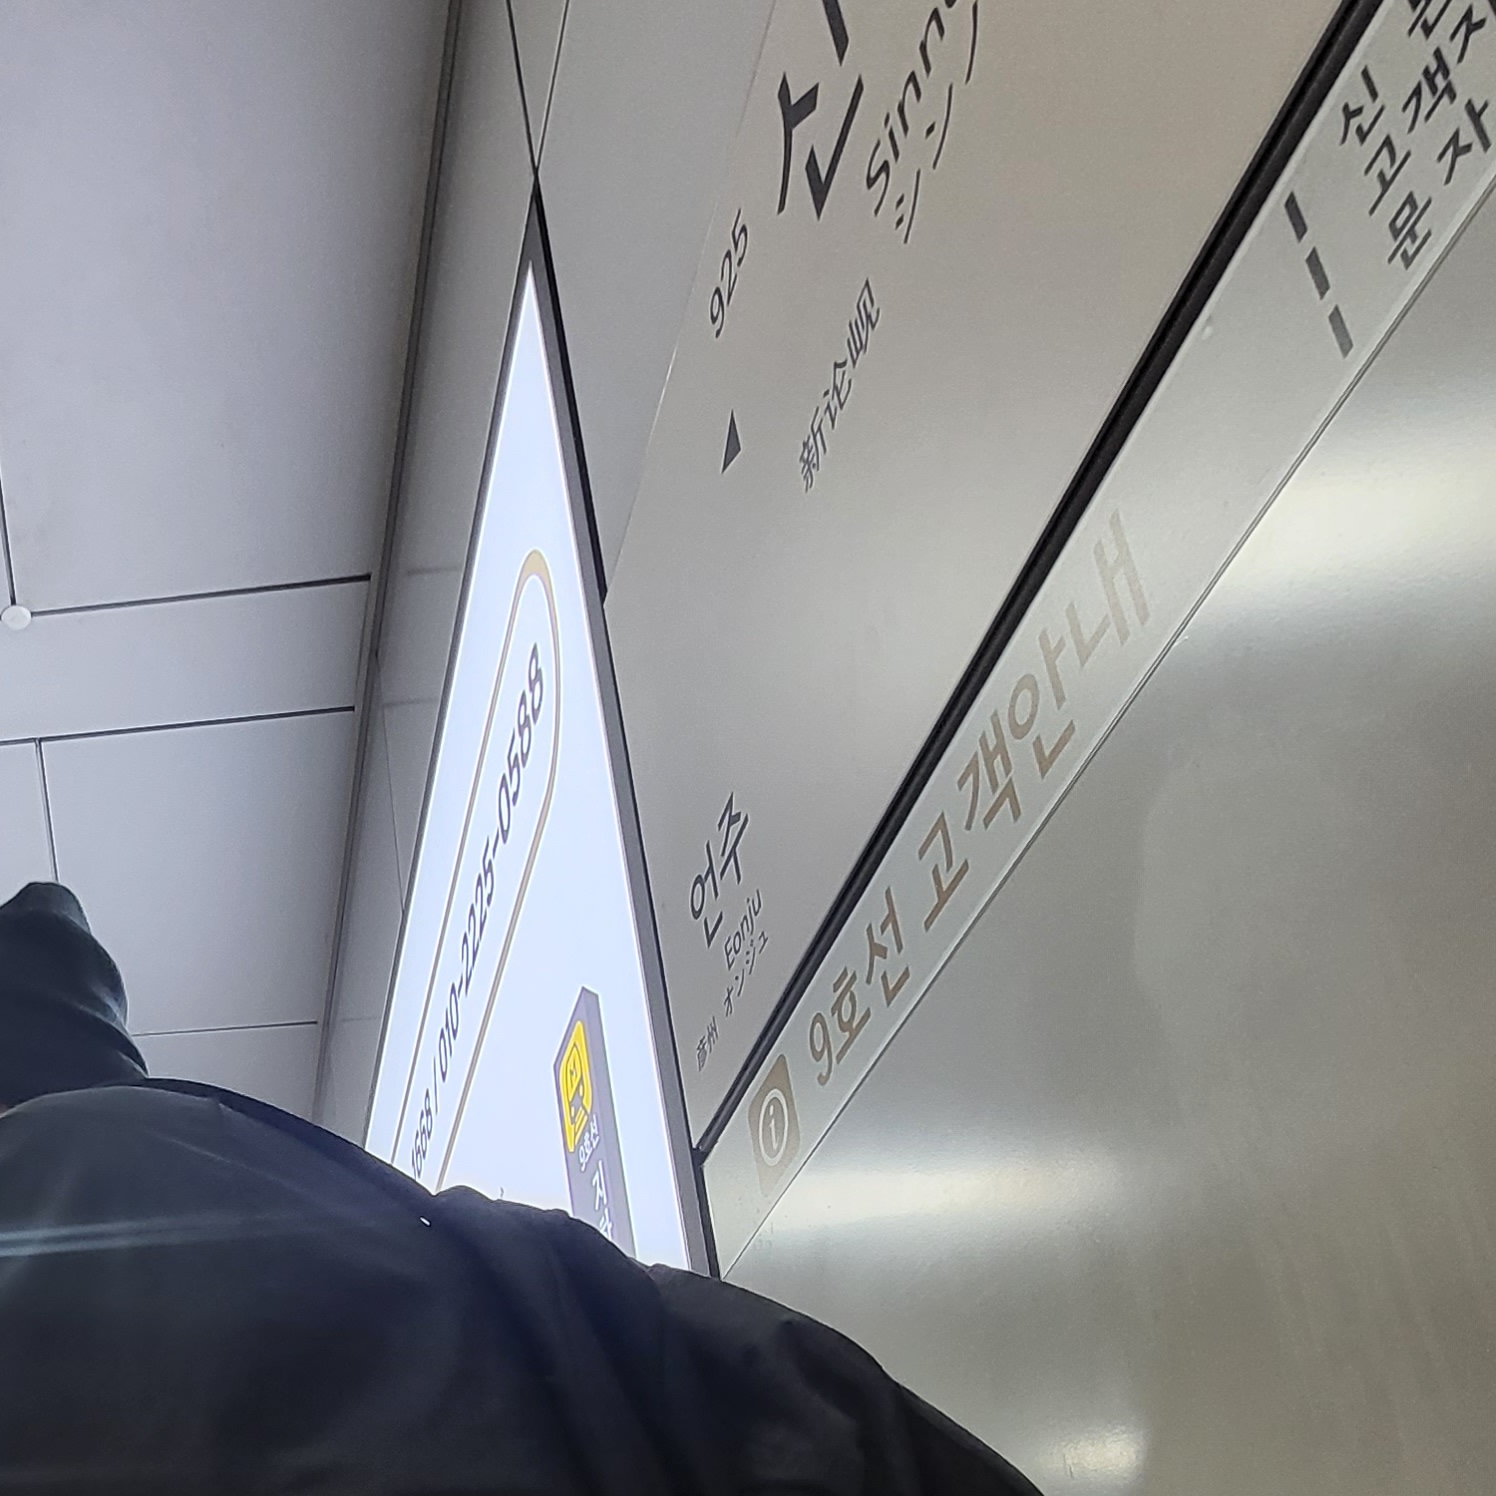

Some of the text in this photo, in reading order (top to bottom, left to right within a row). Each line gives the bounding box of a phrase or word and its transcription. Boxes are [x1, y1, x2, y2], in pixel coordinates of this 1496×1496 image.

[866, 0, 955, 217] Sinn
[710, 207, 748, 338] 925
[439, 643, 543, 1083] 010-2225-0588
[690, 792, 749, 949] 언주
[809, 512, 1150, 1086] 9호선 고객안내
[724, 889, 762, 971] Eonju
[579, 1113, 601, 1172] 9호선
